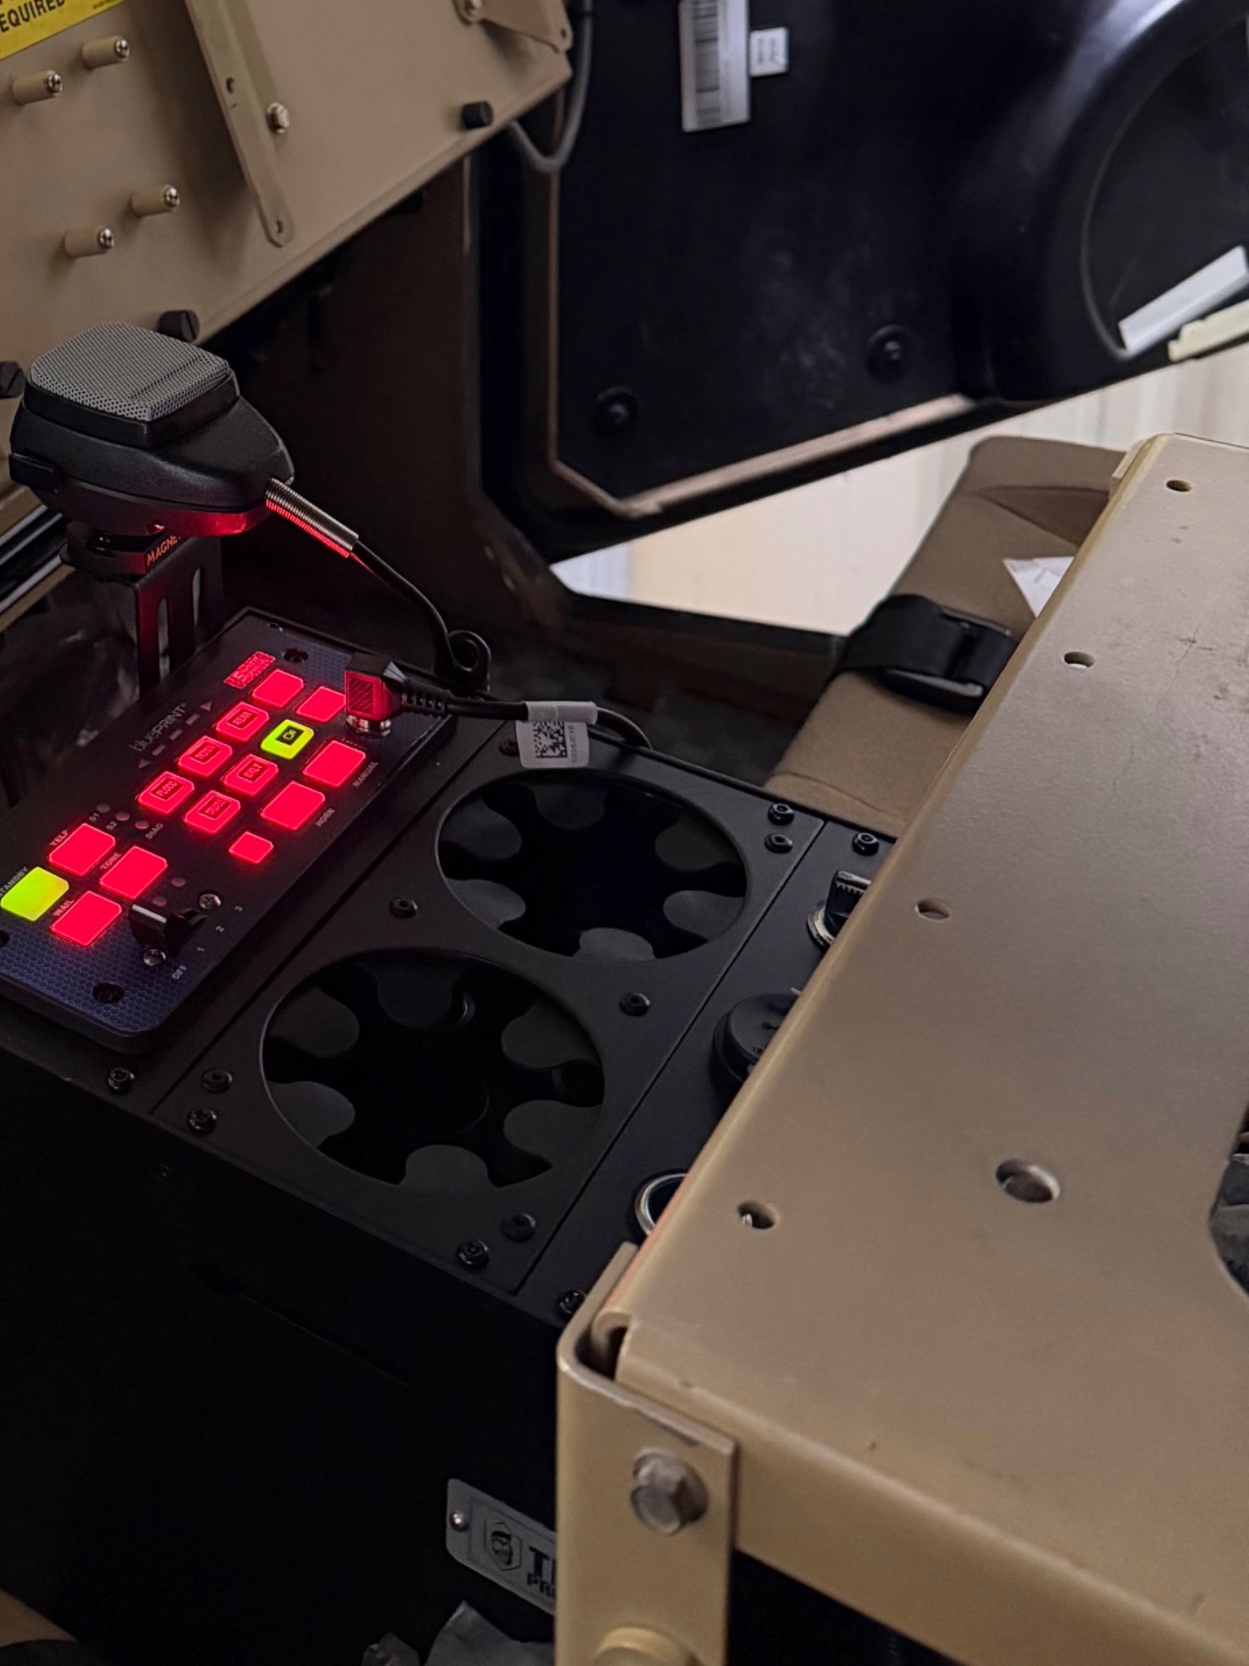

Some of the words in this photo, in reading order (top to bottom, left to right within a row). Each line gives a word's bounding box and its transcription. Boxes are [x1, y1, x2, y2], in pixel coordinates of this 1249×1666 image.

[146, 535, 181, 566] MAGNE
[352, 760, 379, 788] MANUAL
[107, 821, 118, 830] S2
[314, 808, 336, 827] HORN
[50, 830, 68, 847] YELP
[145, 822, 164, 840] DIAG
[100, 852, 121, 871] TONE
[55, 898, 74, 917] WAIL
[172, 965, 187, 979] OFF
